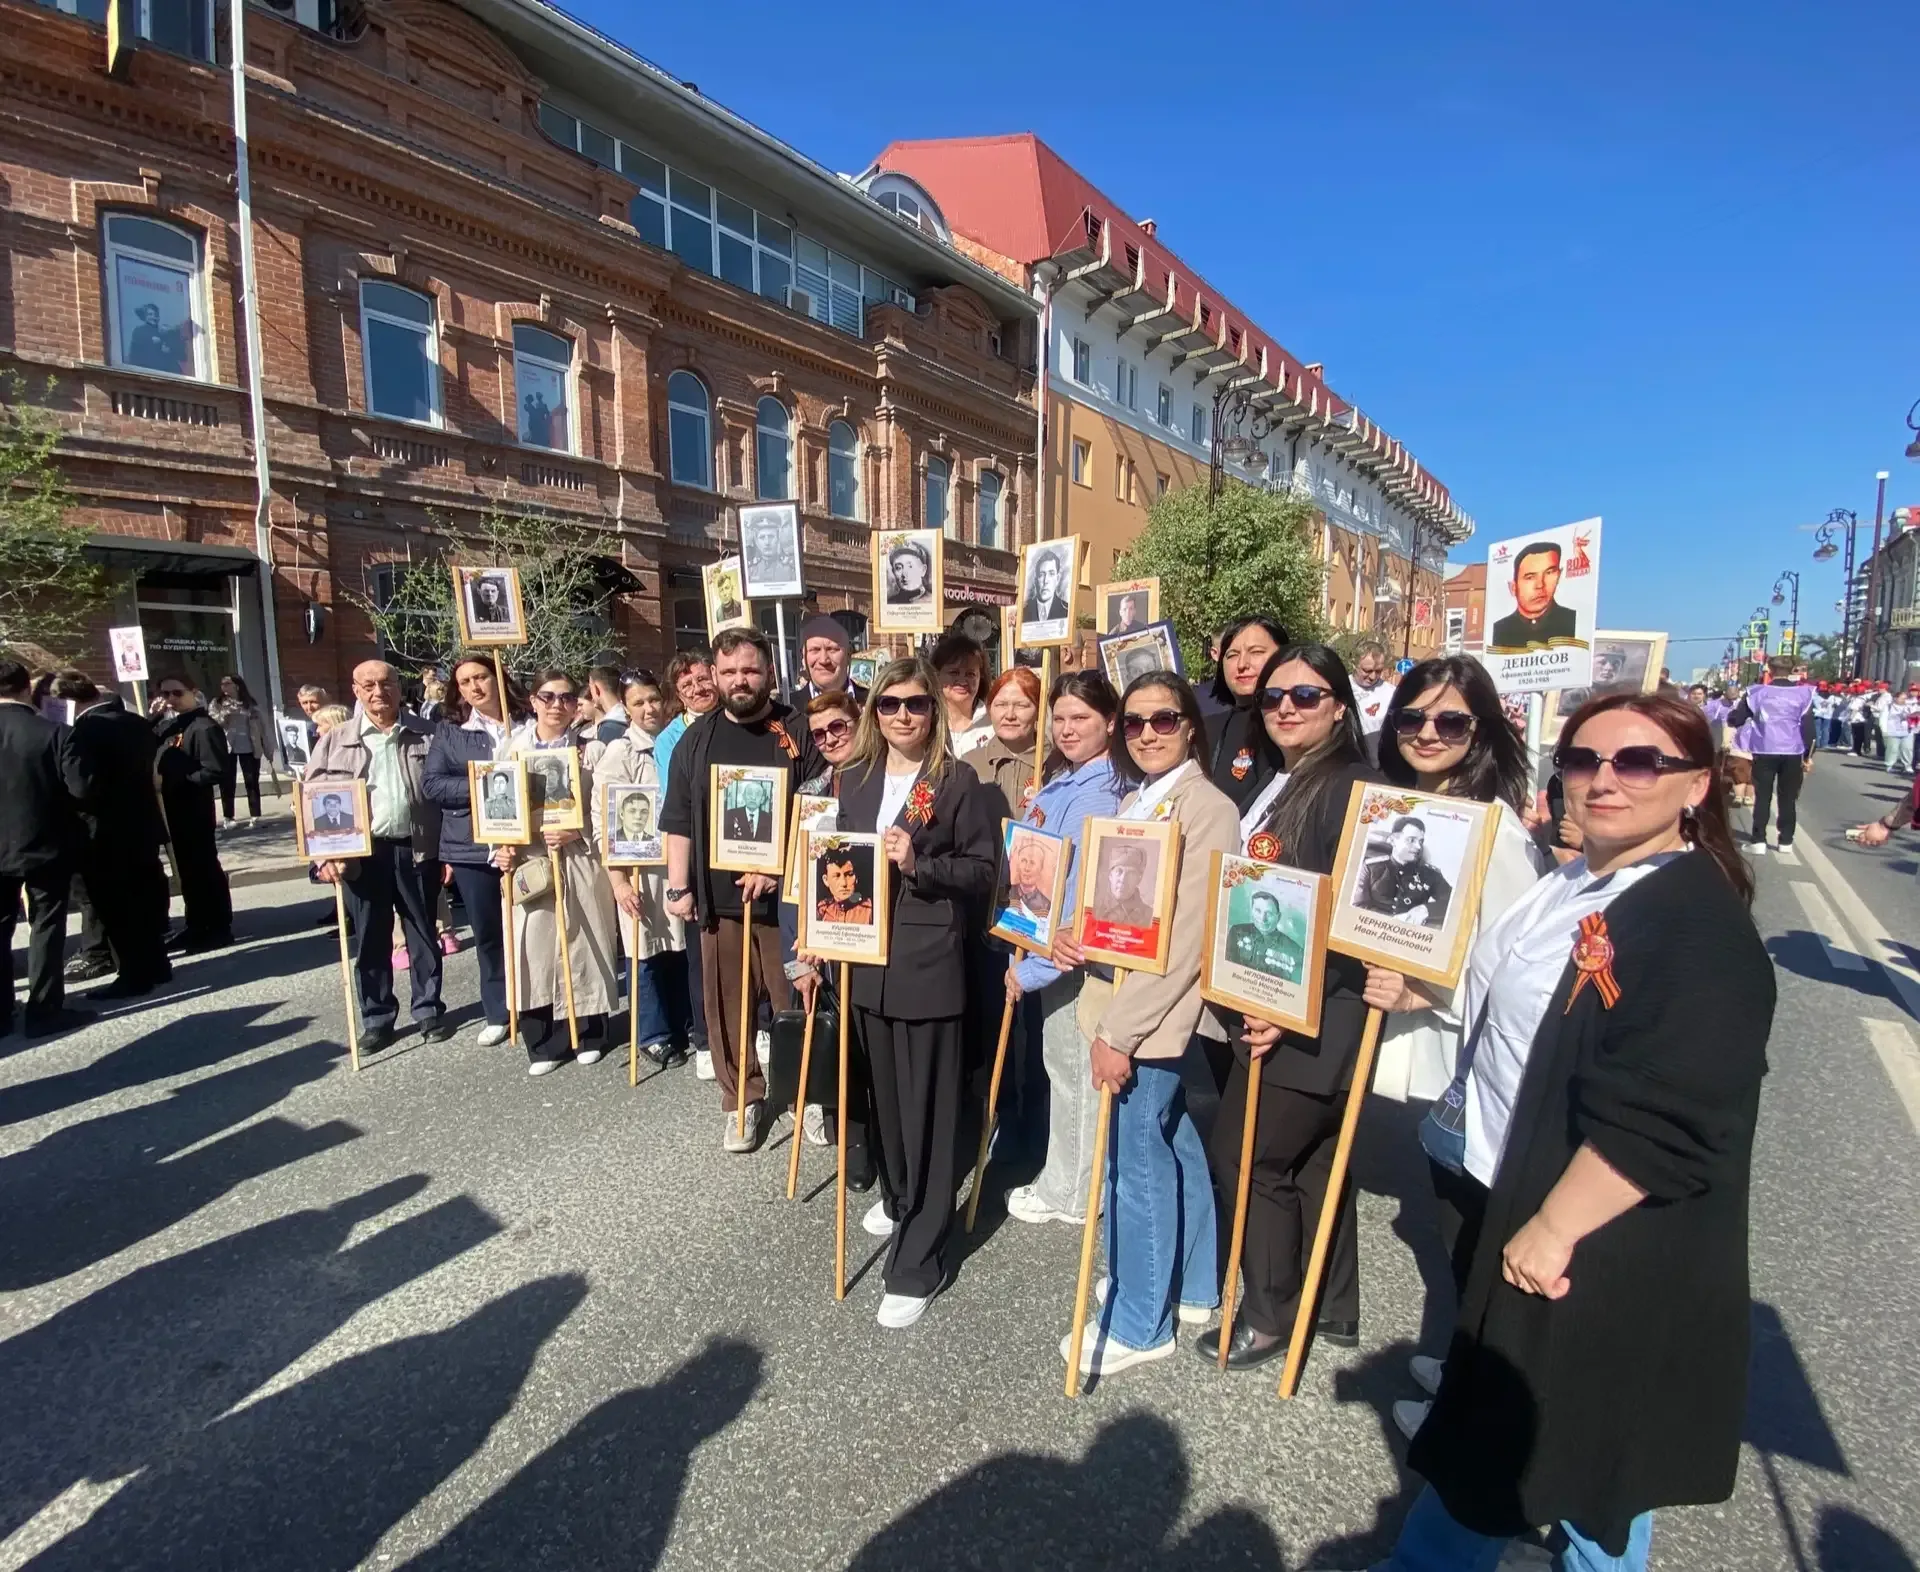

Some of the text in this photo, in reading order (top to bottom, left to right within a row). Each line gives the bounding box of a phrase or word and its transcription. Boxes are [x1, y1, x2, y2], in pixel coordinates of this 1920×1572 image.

[1502, 652, 1569, 671] ДЕНИСОВ
[1500, 667, 1571, 680] Афанасий Андреевич
[1354, 923, 1433, 954] Иван Данилович
[1358, 914, 1434, 944] ЧЕРНЯХОВСКИЙ
[1231, 971, 1258, 986] Василий
[1258, 981, 1295, 998] Иосифович
[1244, 969, 1284, 987] ИГЛОВИКОВ
